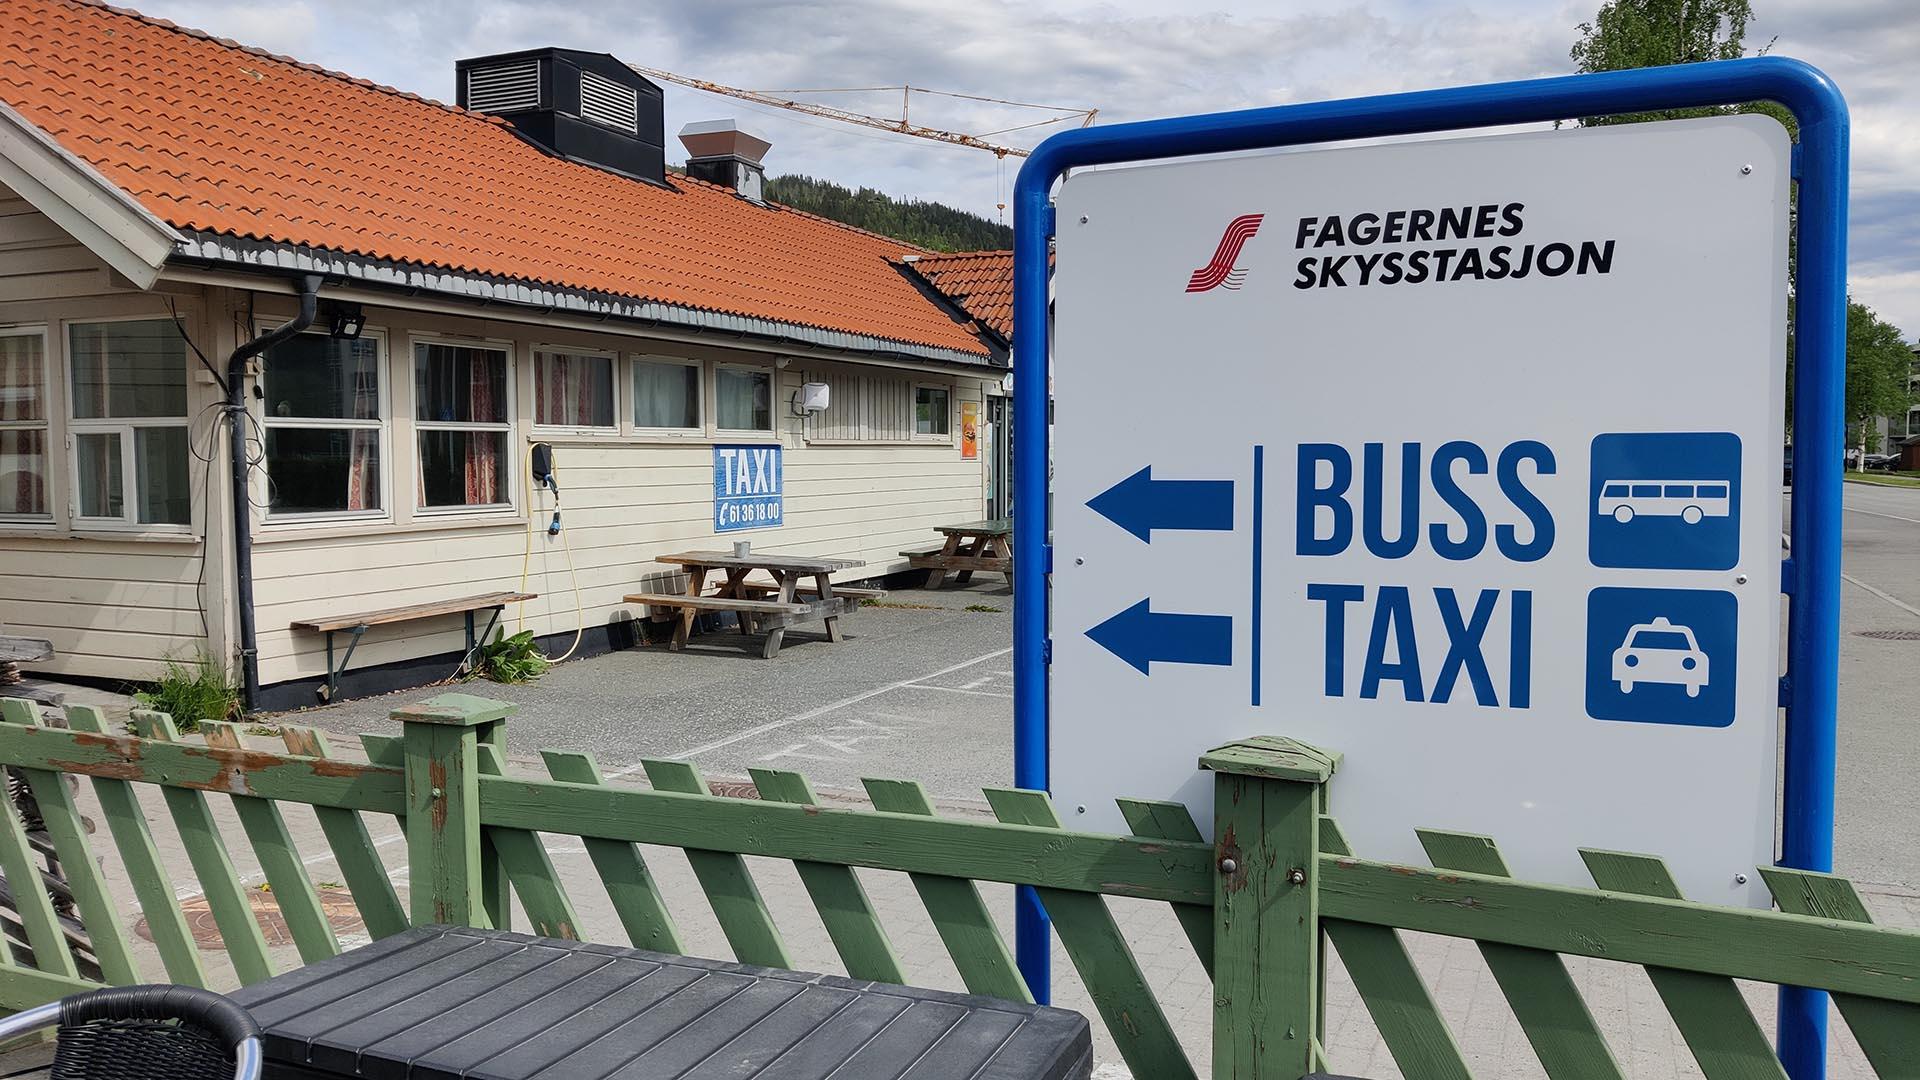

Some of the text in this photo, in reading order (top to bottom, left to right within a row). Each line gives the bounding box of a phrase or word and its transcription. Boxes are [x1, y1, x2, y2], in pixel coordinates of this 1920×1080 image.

[1296, 203, 1524, 249] FAGERNES
[1293, 239, 1615, 289] SKYSSTASJON
[720, 449, 776, 494] TAXI
[730, 502, 779, 522] 61 36 18 00
[1296, 440, 1556, 562] BUSS
[1307, 584, 1532, 708] TAXI
